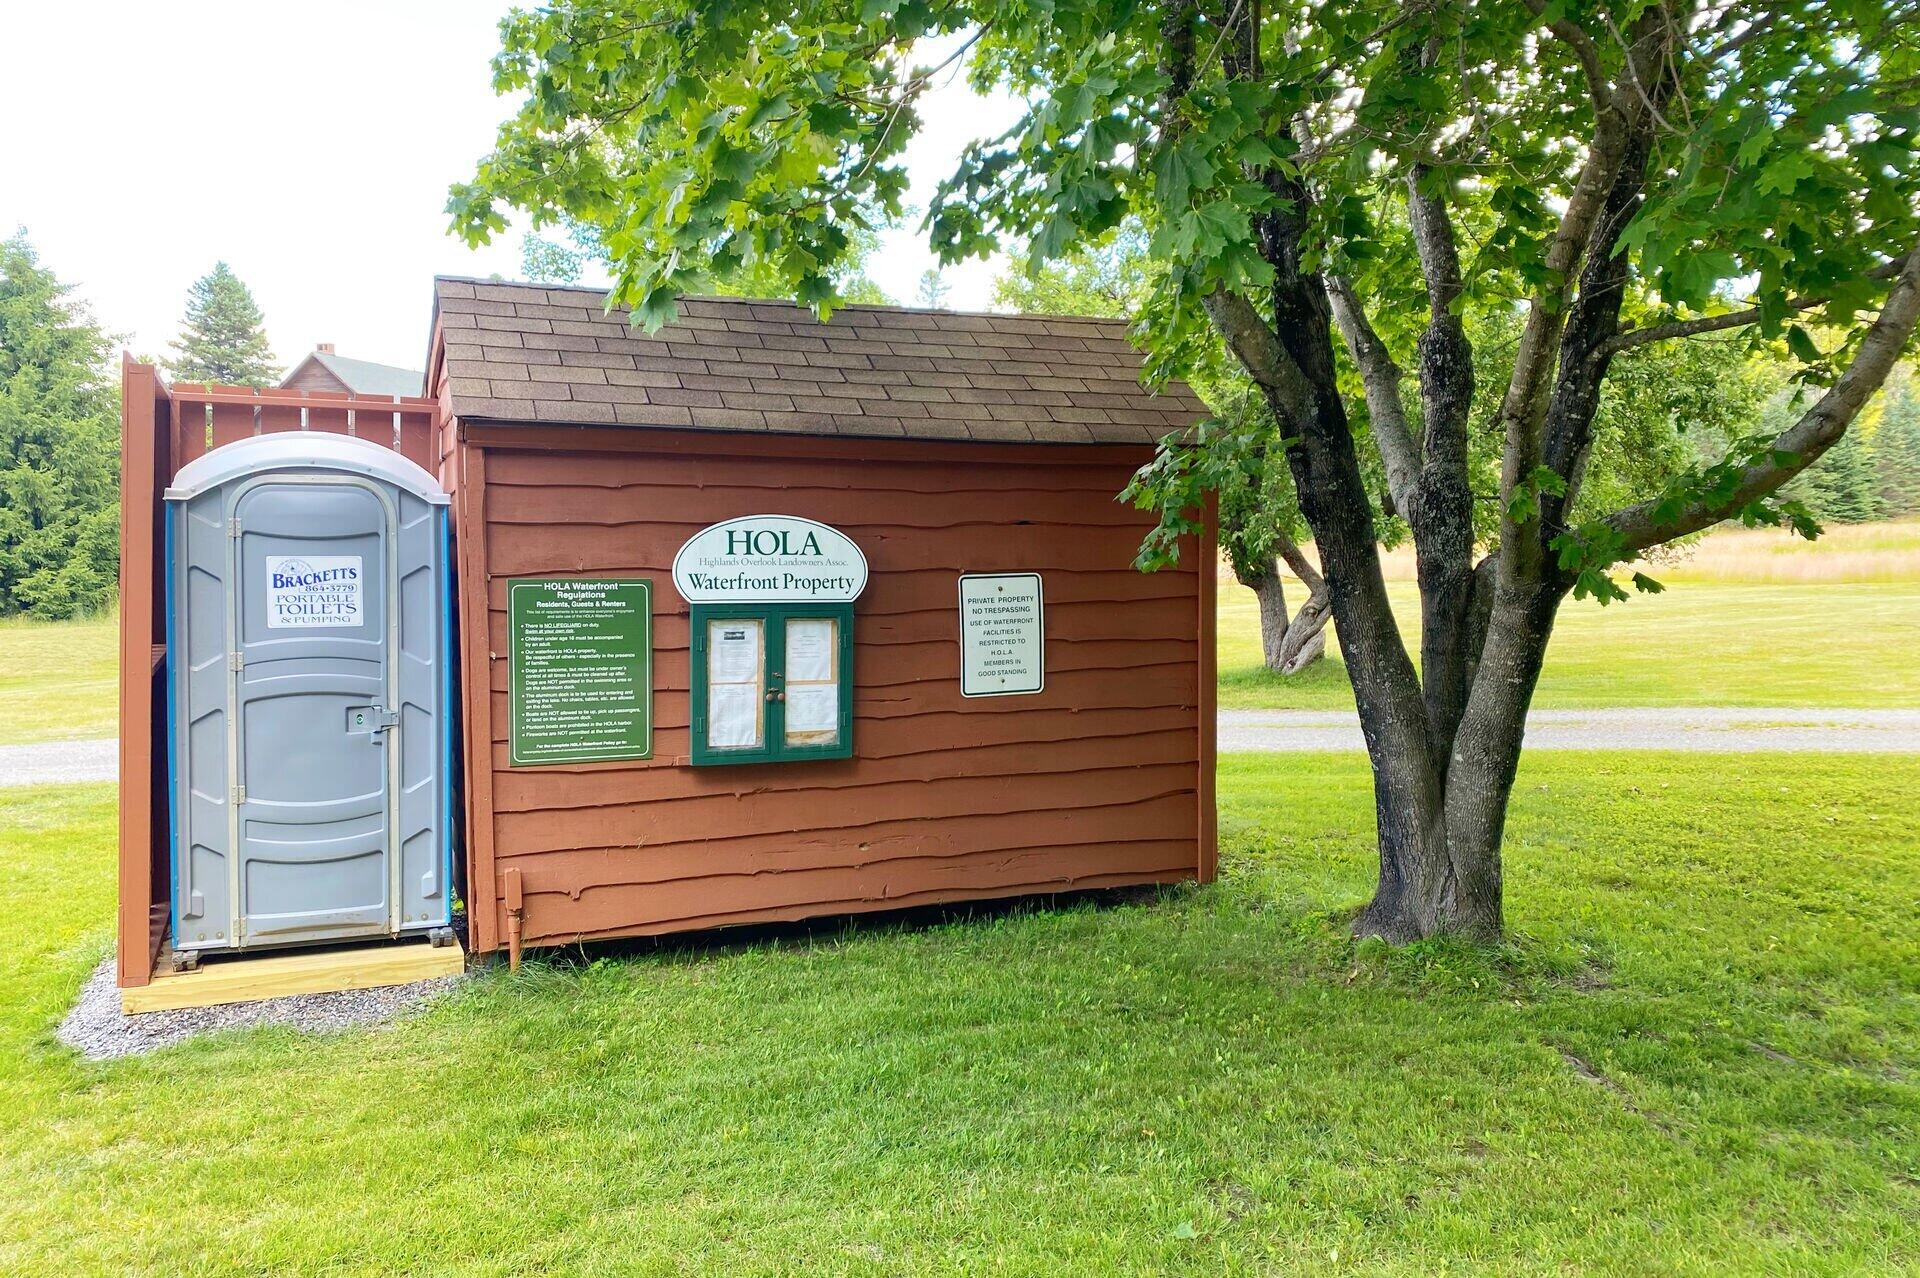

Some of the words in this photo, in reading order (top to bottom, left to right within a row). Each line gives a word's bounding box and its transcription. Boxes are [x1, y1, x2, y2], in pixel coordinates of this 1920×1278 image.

[726, 530, 824, 556] HOLA
[699, 558, 740, 568] Highlands
[741, 558, 777, 567] Overlook
[778, 558, 824, 567] Landowners
[825, 558, 848, 566] Assoc.
[688, 572, 779, 590] Waterfront
[782, 572, 854, 595] Property
[276, 595, 354, 603] PORTABLE
[557, 591, 606, 600] Regulations
[274, 603, 357, 615] TOILETS
